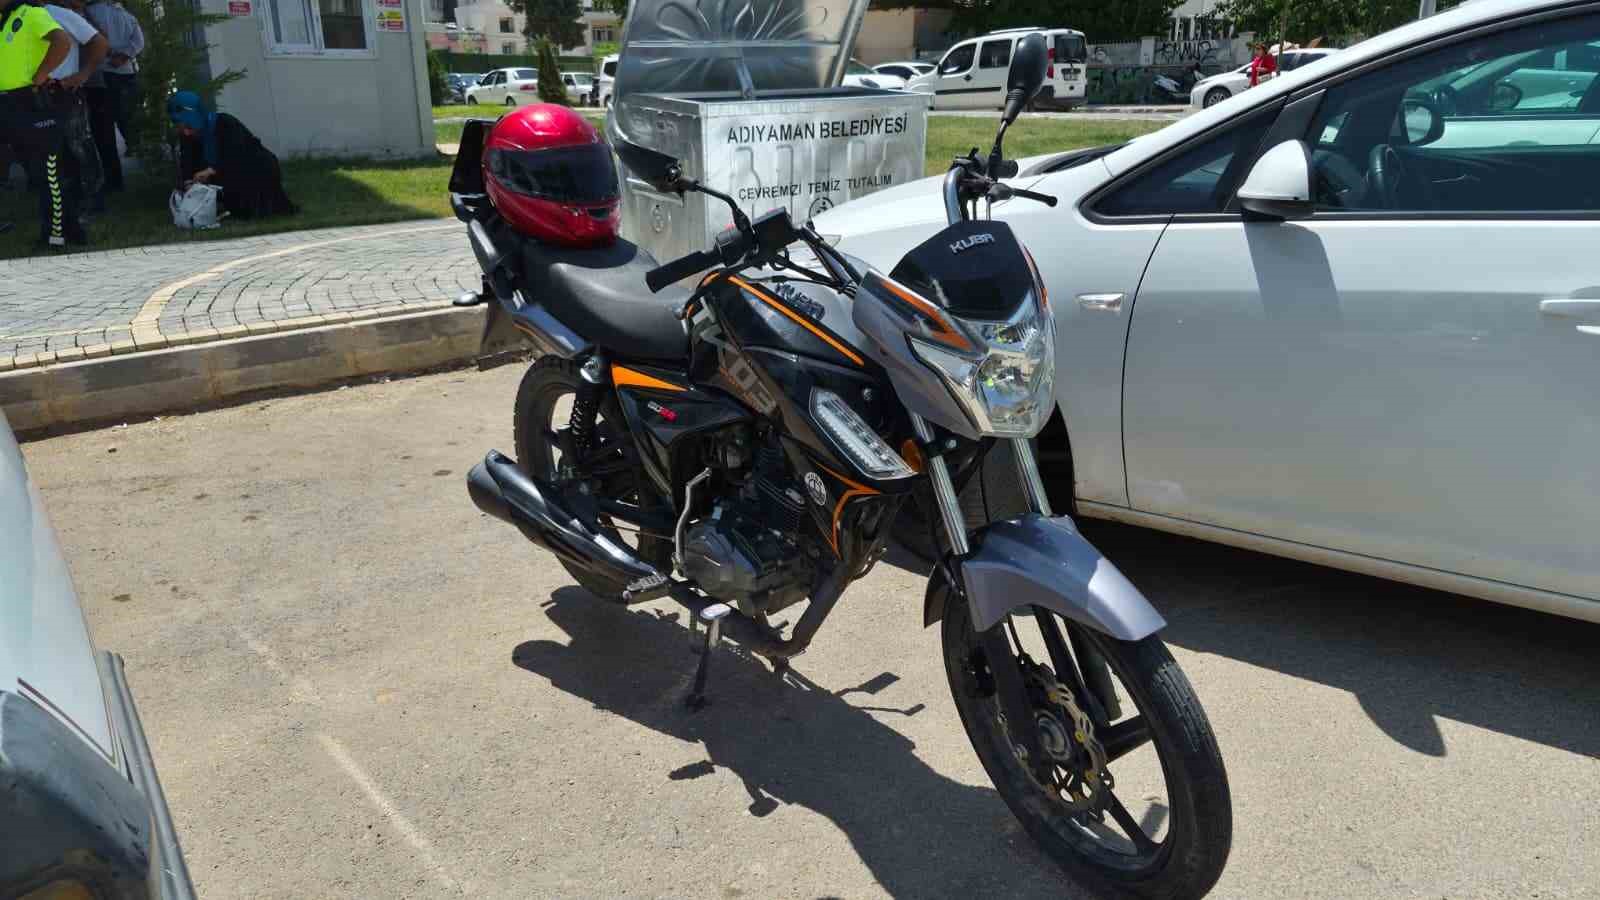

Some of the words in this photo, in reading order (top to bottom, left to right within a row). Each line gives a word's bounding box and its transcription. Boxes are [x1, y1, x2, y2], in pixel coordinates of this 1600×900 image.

[727, 122, 815, 144] ADIYAMAN
[819, 112, 908, 139] BELEDİYESİ
[807, 179, 841, 196] TEMİZ
[846, 174, 893, 189] TUTALIM
[949, 233, 995, 253] KUBA
